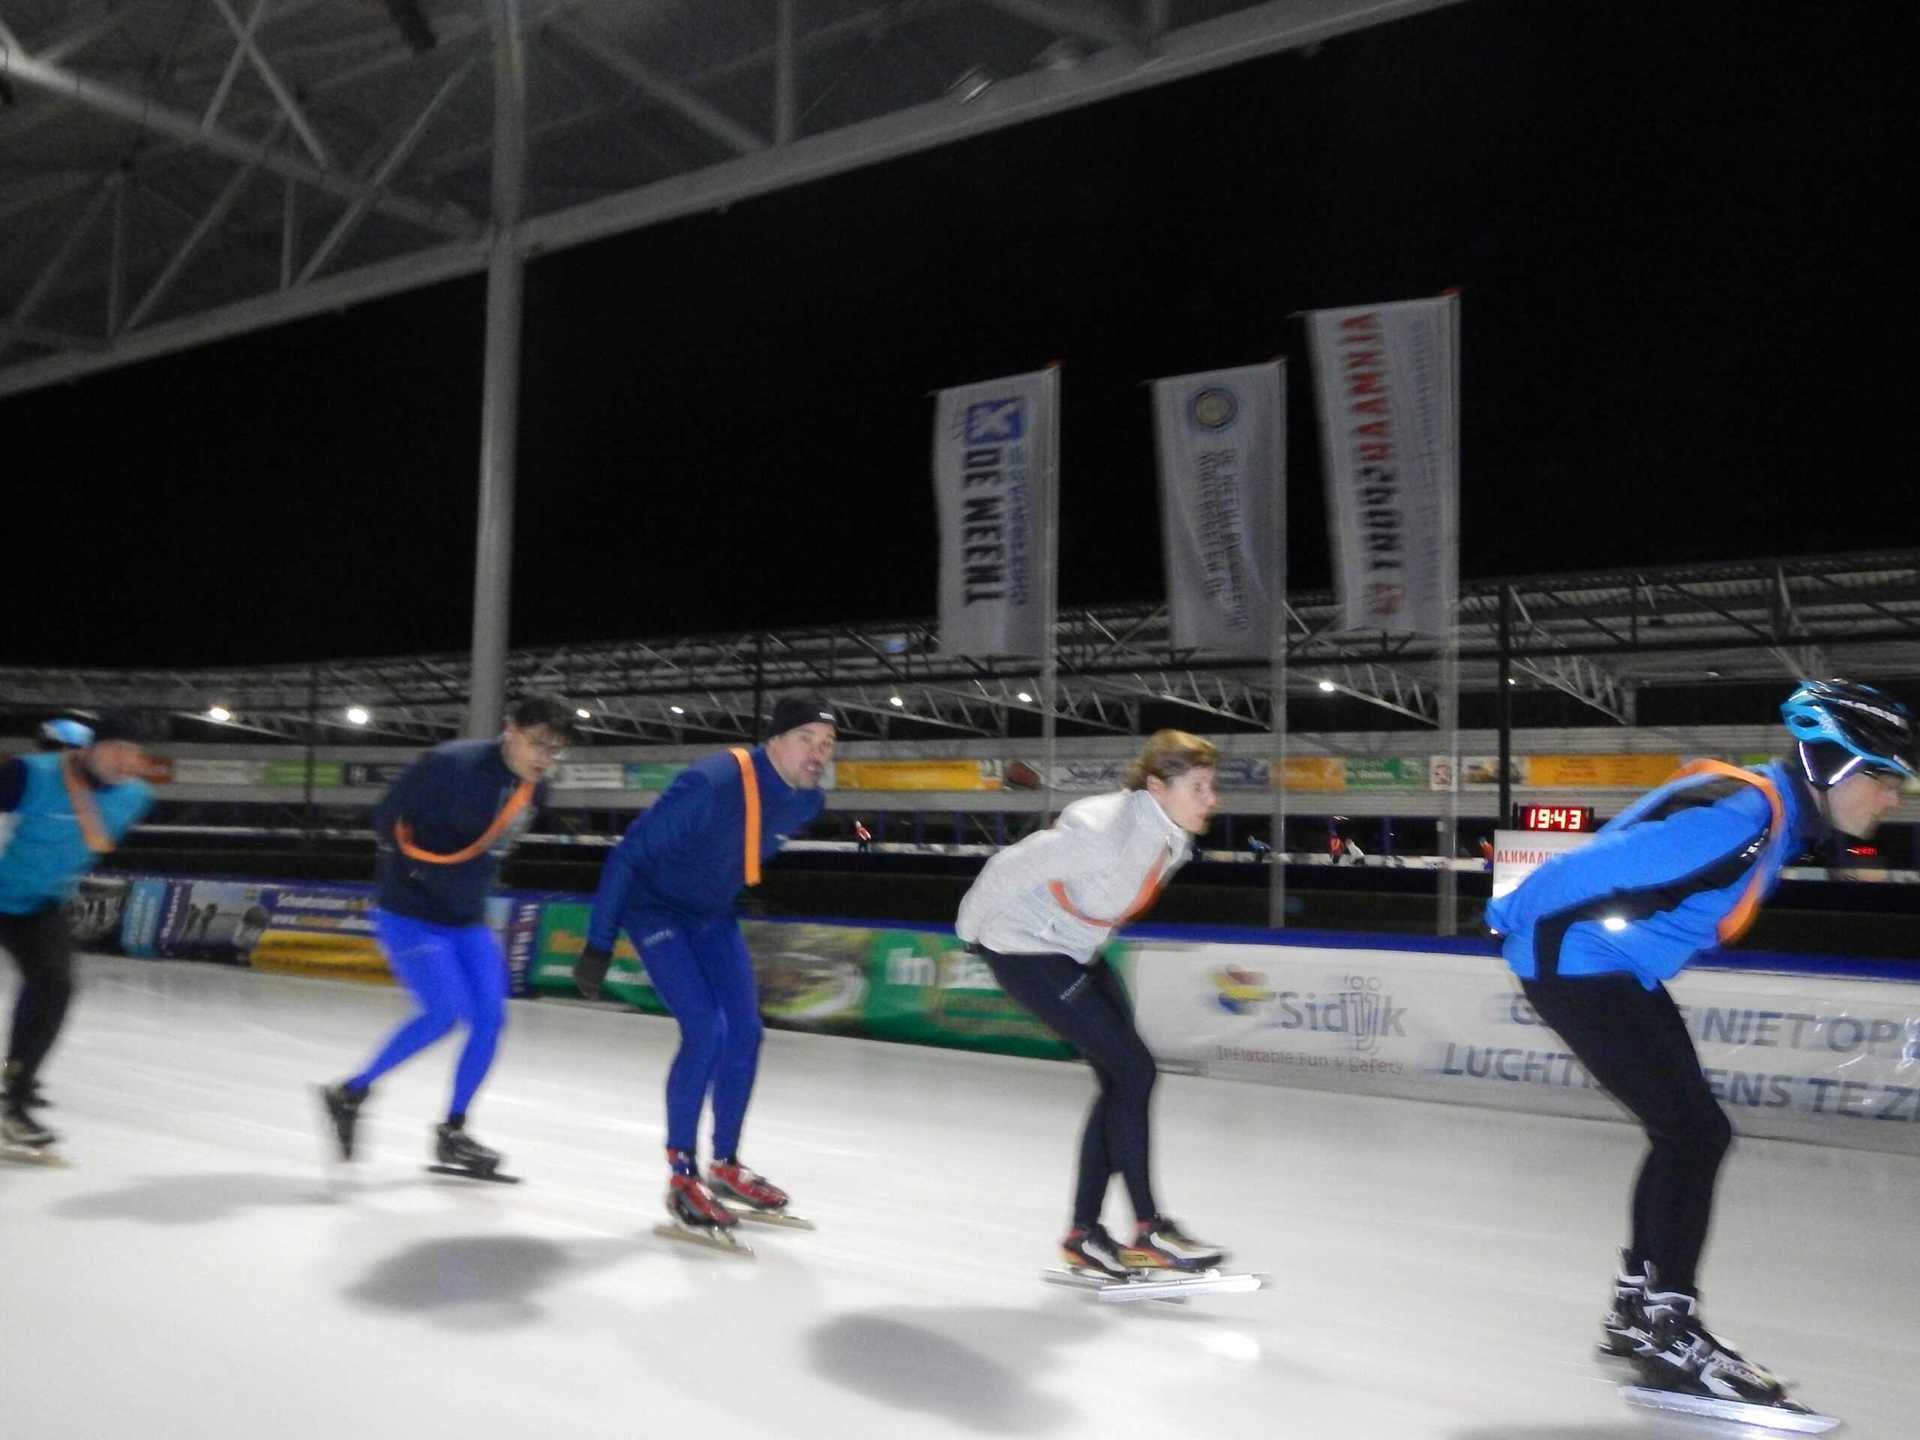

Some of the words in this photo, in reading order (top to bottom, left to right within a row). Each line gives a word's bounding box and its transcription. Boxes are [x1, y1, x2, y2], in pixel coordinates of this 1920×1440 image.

[1529, 808, 1582, 830] 19:43
[1702, 1006, 1817, 1050] NIET
[1823, 1015, 1900, 1056] OP
[1298, 1051, 1329, 1067] Fun
[1348, 1054, 1405, 1075] Safety
[1807, 1076, 1869, 1118] TE
